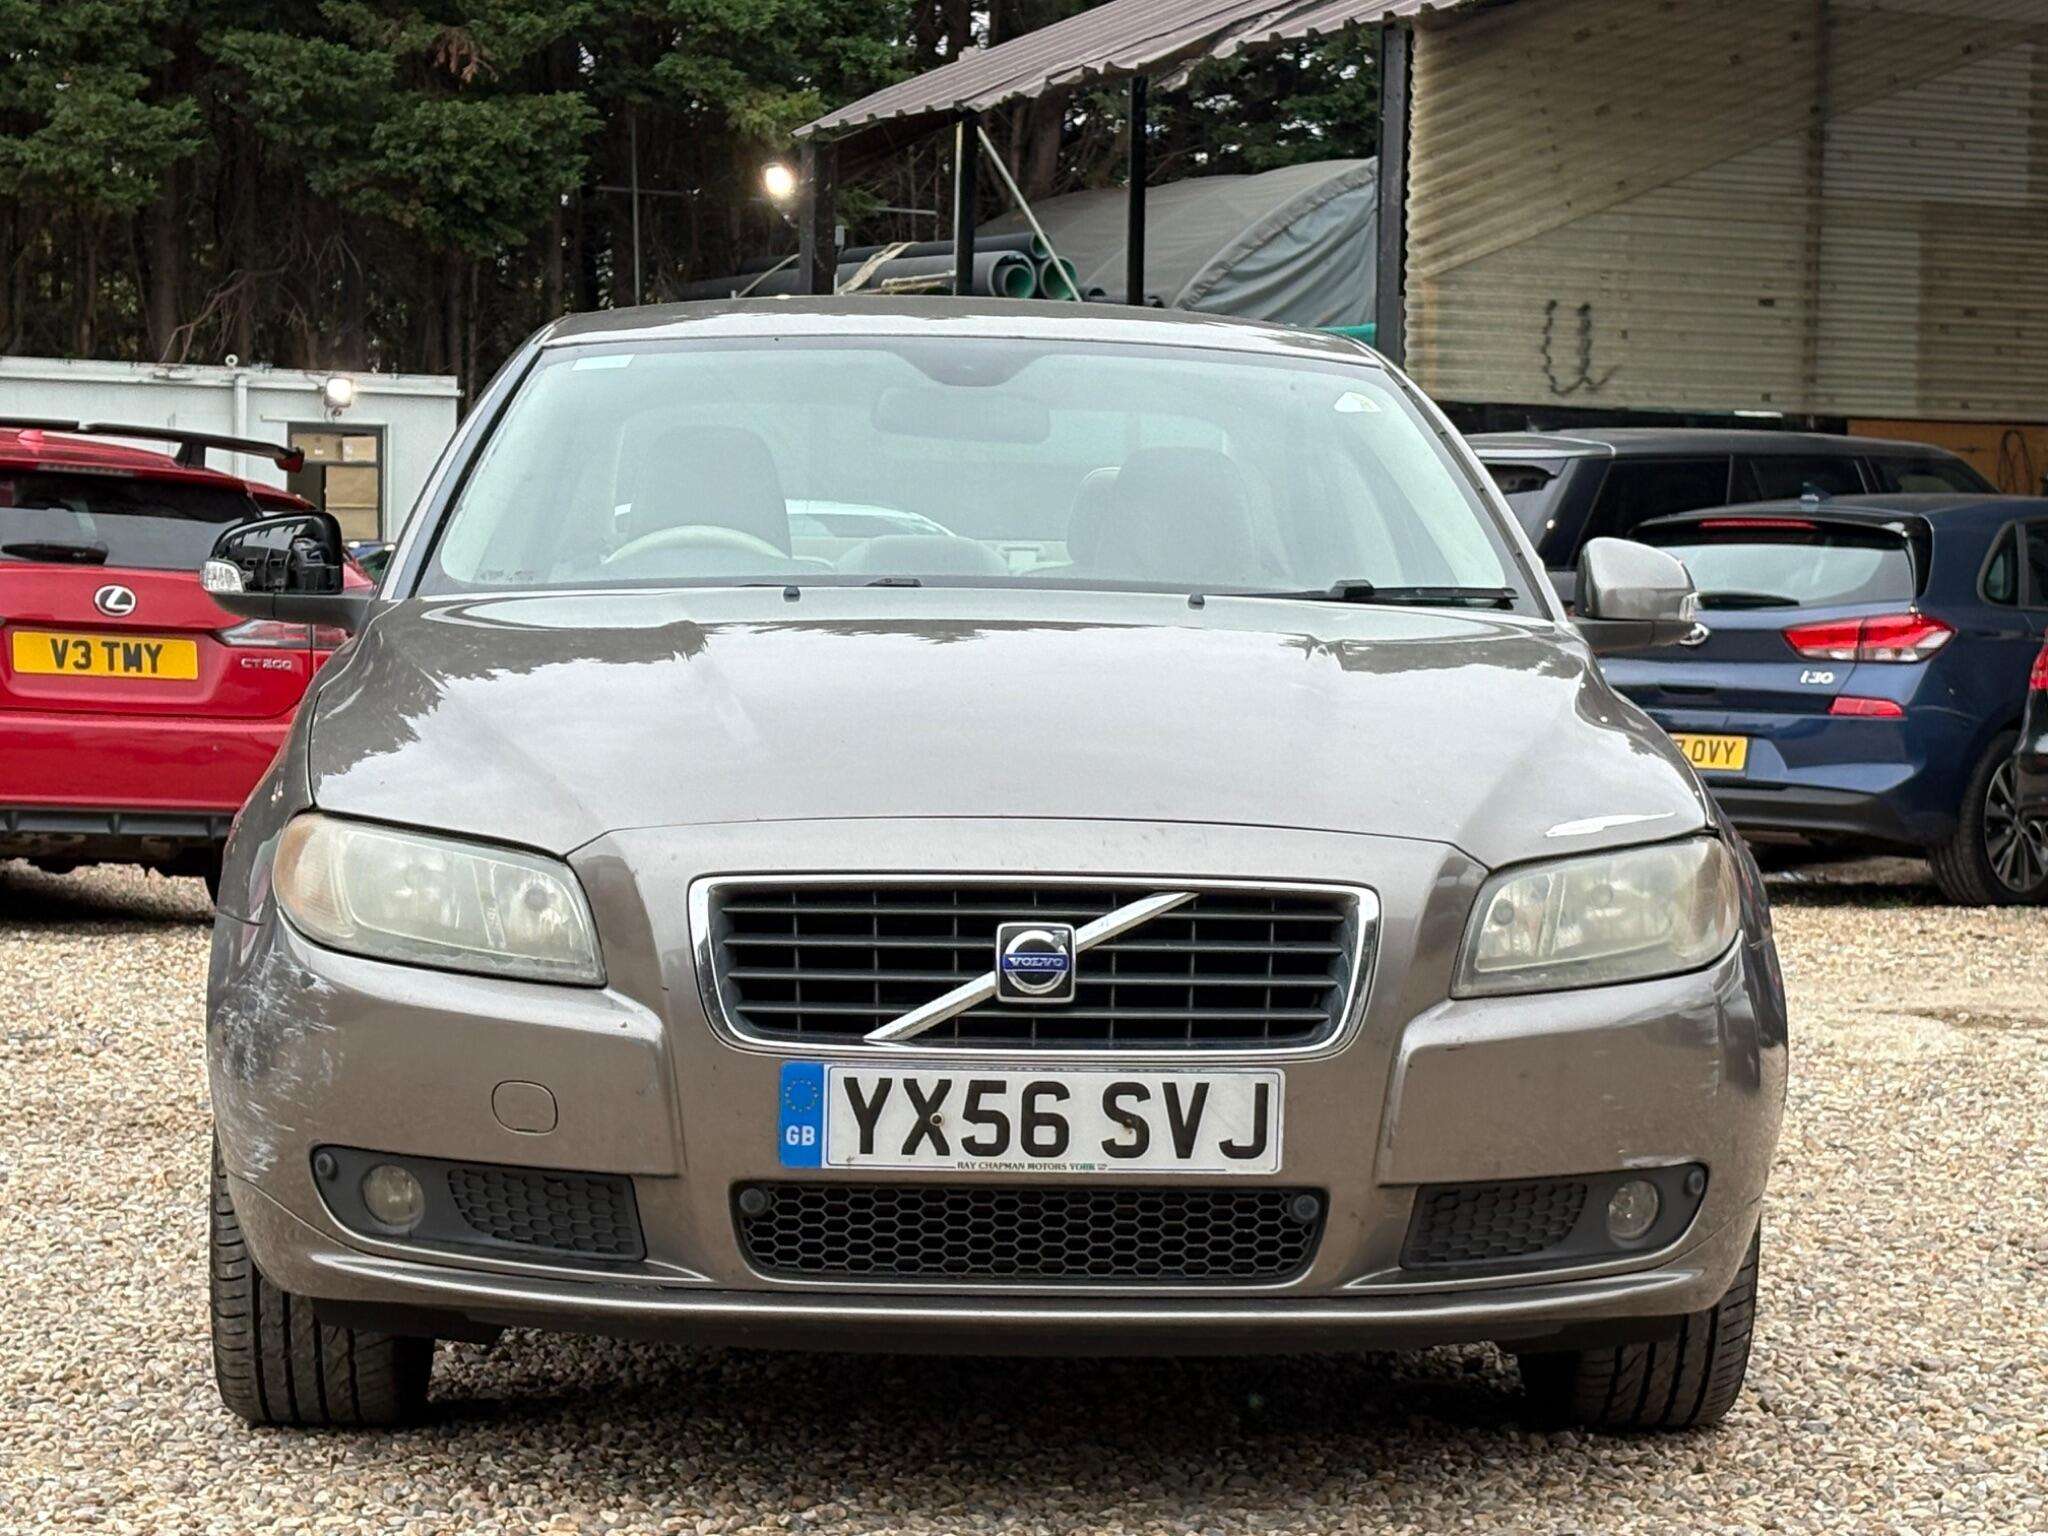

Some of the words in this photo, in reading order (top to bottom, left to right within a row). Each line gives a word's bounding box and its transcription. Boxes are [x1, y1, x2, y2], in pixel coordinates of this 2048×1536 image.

[50, 638, 92, 670] V3
[101, 640, 164, 674] TMY
[1691, 739, 1737, 765] OVY
[1008, 957, 1064, 967] VOLVO
[843, 1076, 1070, 1158] YX56
[1101, 1080, 1270, 1159] SVJ
[786, 1125, 815, 1146] GB
[957, 1161, 976, 1169] RAY
[978, 1161, 1026, 1170] CHAPMAN
[1027, 1162, 1068, 1171] MOTORS
[1069, 1162, 1096, 1171] YORK
